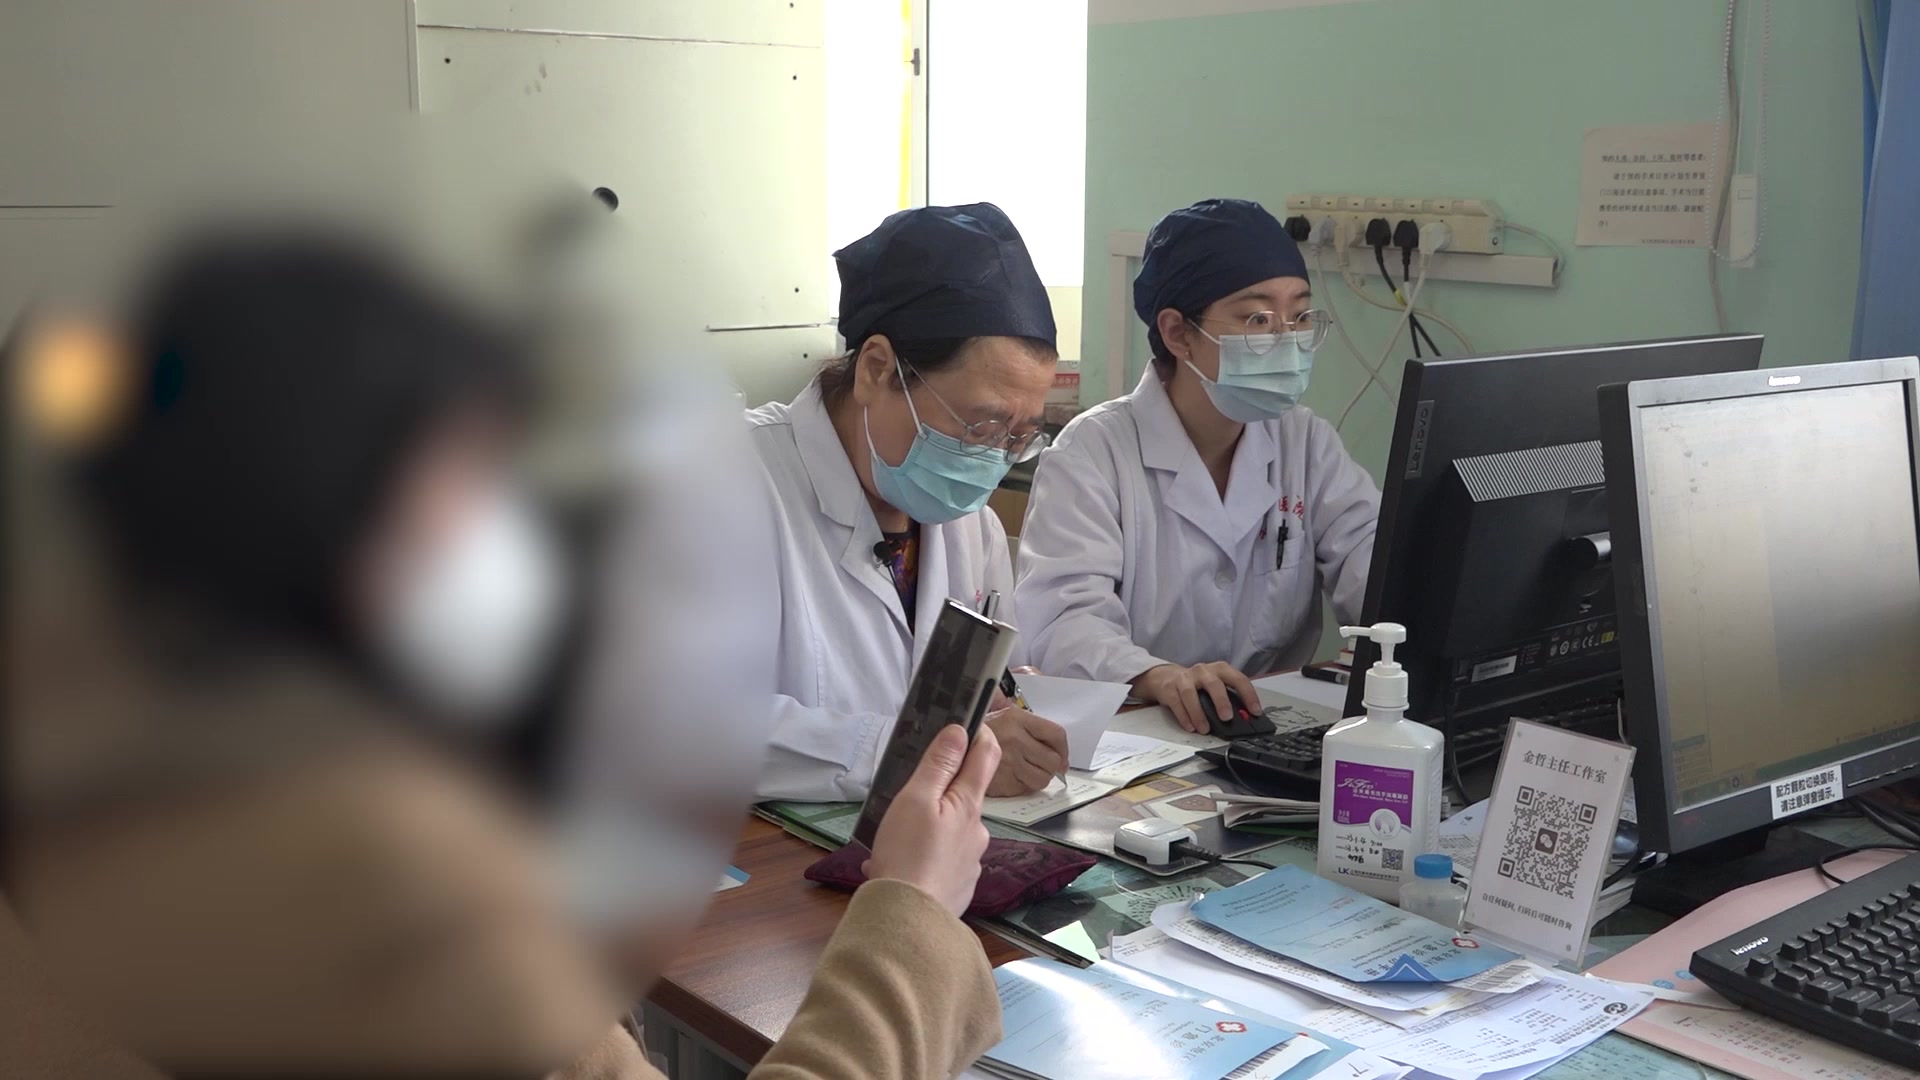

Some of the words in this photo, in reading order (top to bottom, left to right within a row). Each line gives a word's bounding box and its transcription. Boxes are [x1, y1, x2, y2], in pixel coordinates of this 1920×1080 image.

[1409, 407, 1429, 472] Lenovo
[1521, 749, 1608, 785] 金哲主任工作室
[1729, 936, 1769, 956] lenovo
